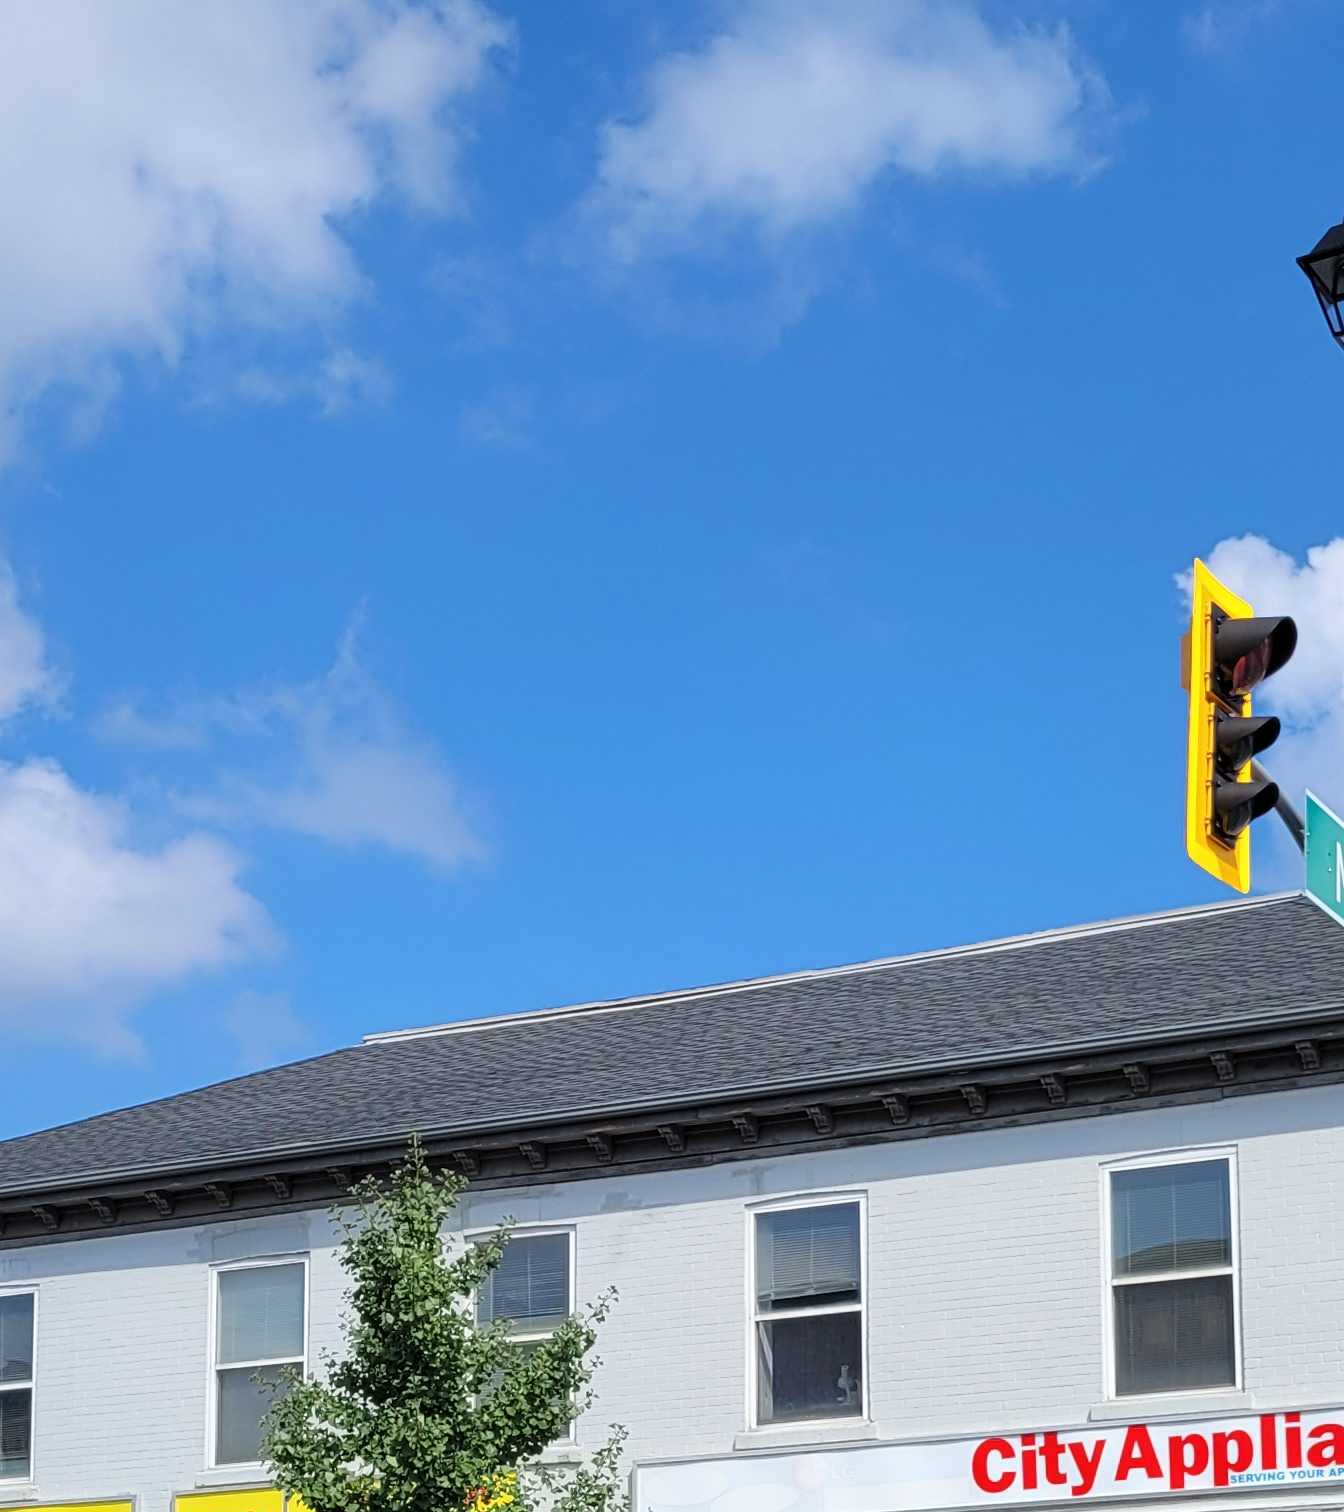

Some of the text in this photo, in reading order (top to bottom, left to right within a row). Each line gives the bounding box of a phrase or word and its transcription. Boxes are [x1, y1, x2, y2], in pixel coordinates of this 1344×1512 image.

[972, 1430, 1107, 1497] City
[1230, 1472, 1285, 1484] SERVING
[1290, 1468, 1325, 1480] YOUR
